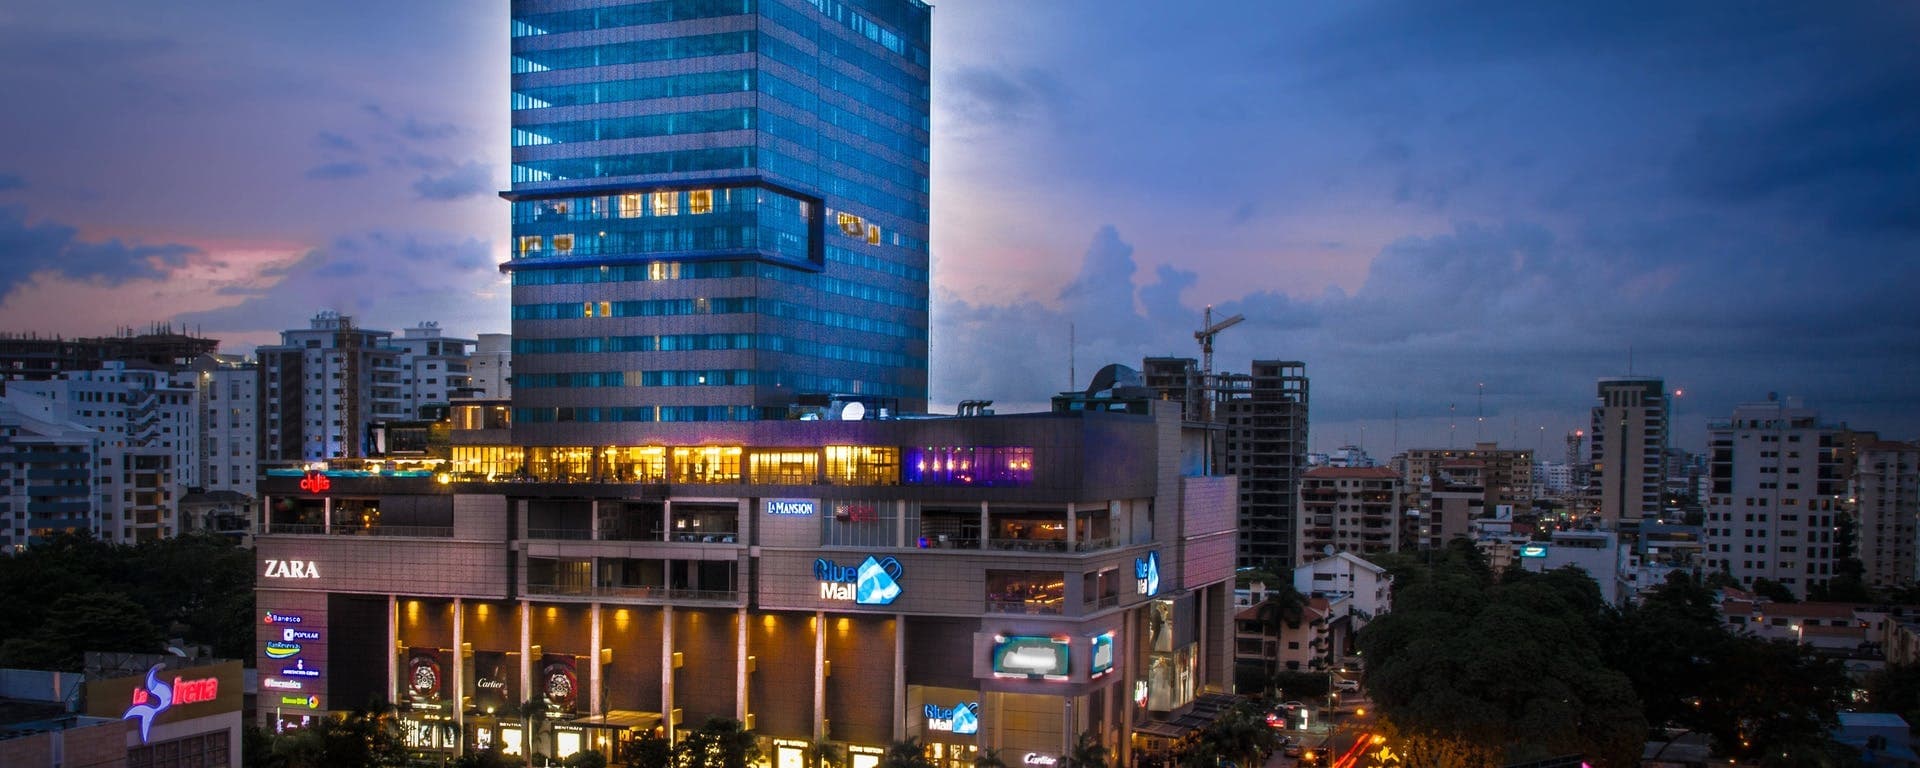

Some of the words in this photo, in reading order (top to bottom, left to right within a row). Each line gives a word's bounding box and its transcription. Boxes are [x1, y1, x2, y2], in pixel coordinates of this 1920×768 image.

[776, 502, 813, 514] MANSION
[264, 560, 320, 579] ZARA
[814, 557, 856, 581] Blue
[821, 582, 856, 601] Mall
[273, 614, 301, 623] Banesco
[477, 677, 504, 690] Cartier
[133, 688, 148, 705] La
[924, 704, 952, 719] Blue
[929, 719, 952, 731] Mall
[1024, 753, 1056, 765] Cartier
